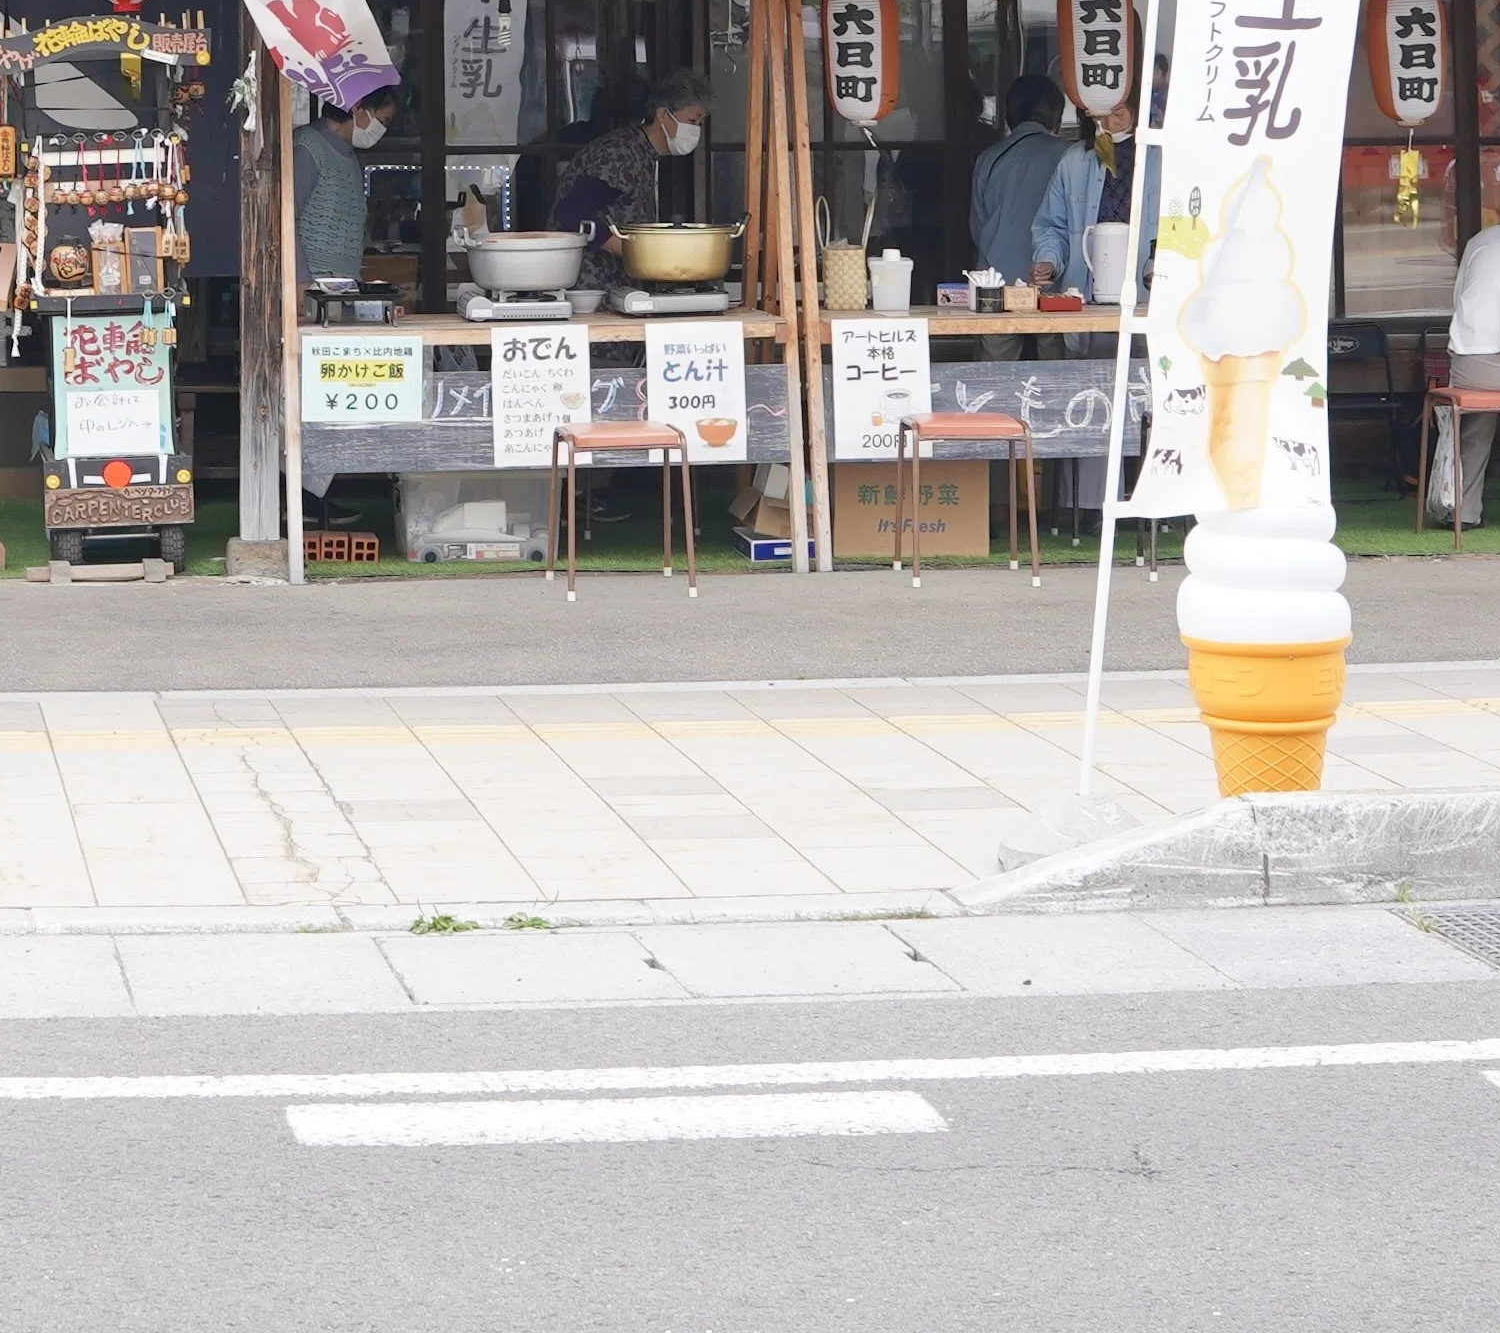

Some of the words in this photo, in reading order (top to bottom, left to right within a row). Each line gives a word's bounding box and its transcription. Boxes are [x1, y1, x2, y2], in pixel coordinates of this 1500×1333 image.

[33, 17, 150, 57] 花輪ばやし
[152, 32, 208, 55] 販売屋台
[832, 3, 877, 103] 六日町
[1395, 7, 1439, 103] 六日町
[842, 329, 918, 345] アートヒルズ
[502, 335, 578, 363] おでん
[664, 342, 727, 356] 野菜いっぱい
[866, 346, 896, 360] 本格
[320, 363, 405, 380] 卵かけご飯
[662, 358, 729, 383] とん汁
[846, 364, 918, 382] コーヒー
[75, 394, 140, 410] お会計は
[668, 395, 716, 410] 300円
[504, 442, 552, 454] 糸こんにゃ
[51, 498, 155, 526] CARPENTER
[155, 496, 191, 517] CLUB
[902, 517, 947, 534] Fesh
